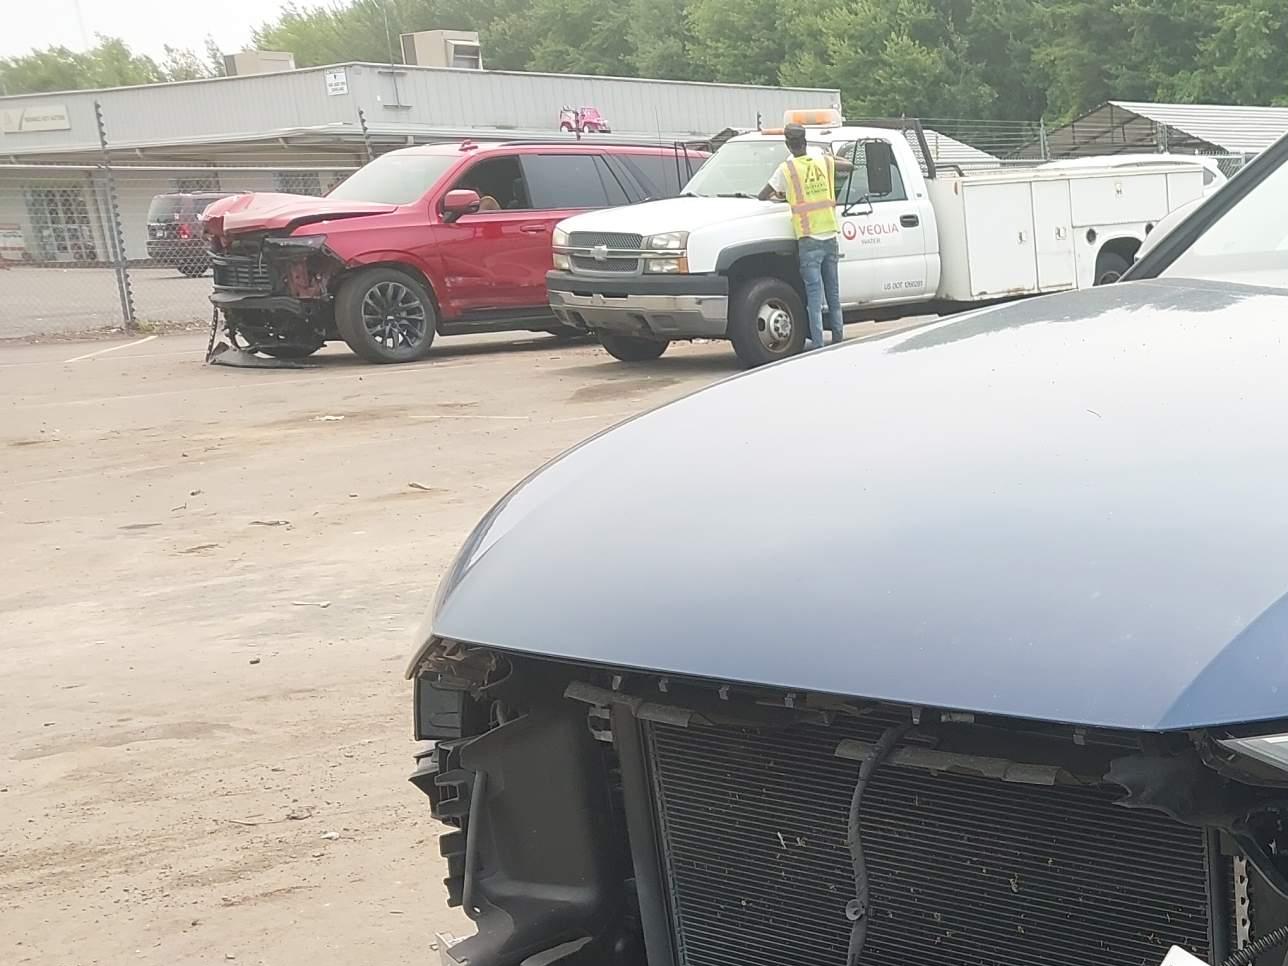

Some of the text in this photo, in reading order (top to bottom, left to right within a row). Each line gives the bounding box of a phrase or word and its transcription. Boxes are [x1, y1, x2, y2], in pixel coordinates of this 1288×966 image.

[858, 223, 899, 236] VEOLIA
[861, 237, 881, 245] WATER
[883, 282, 892, 290] US
[892, 281, 903, 289] DOT
